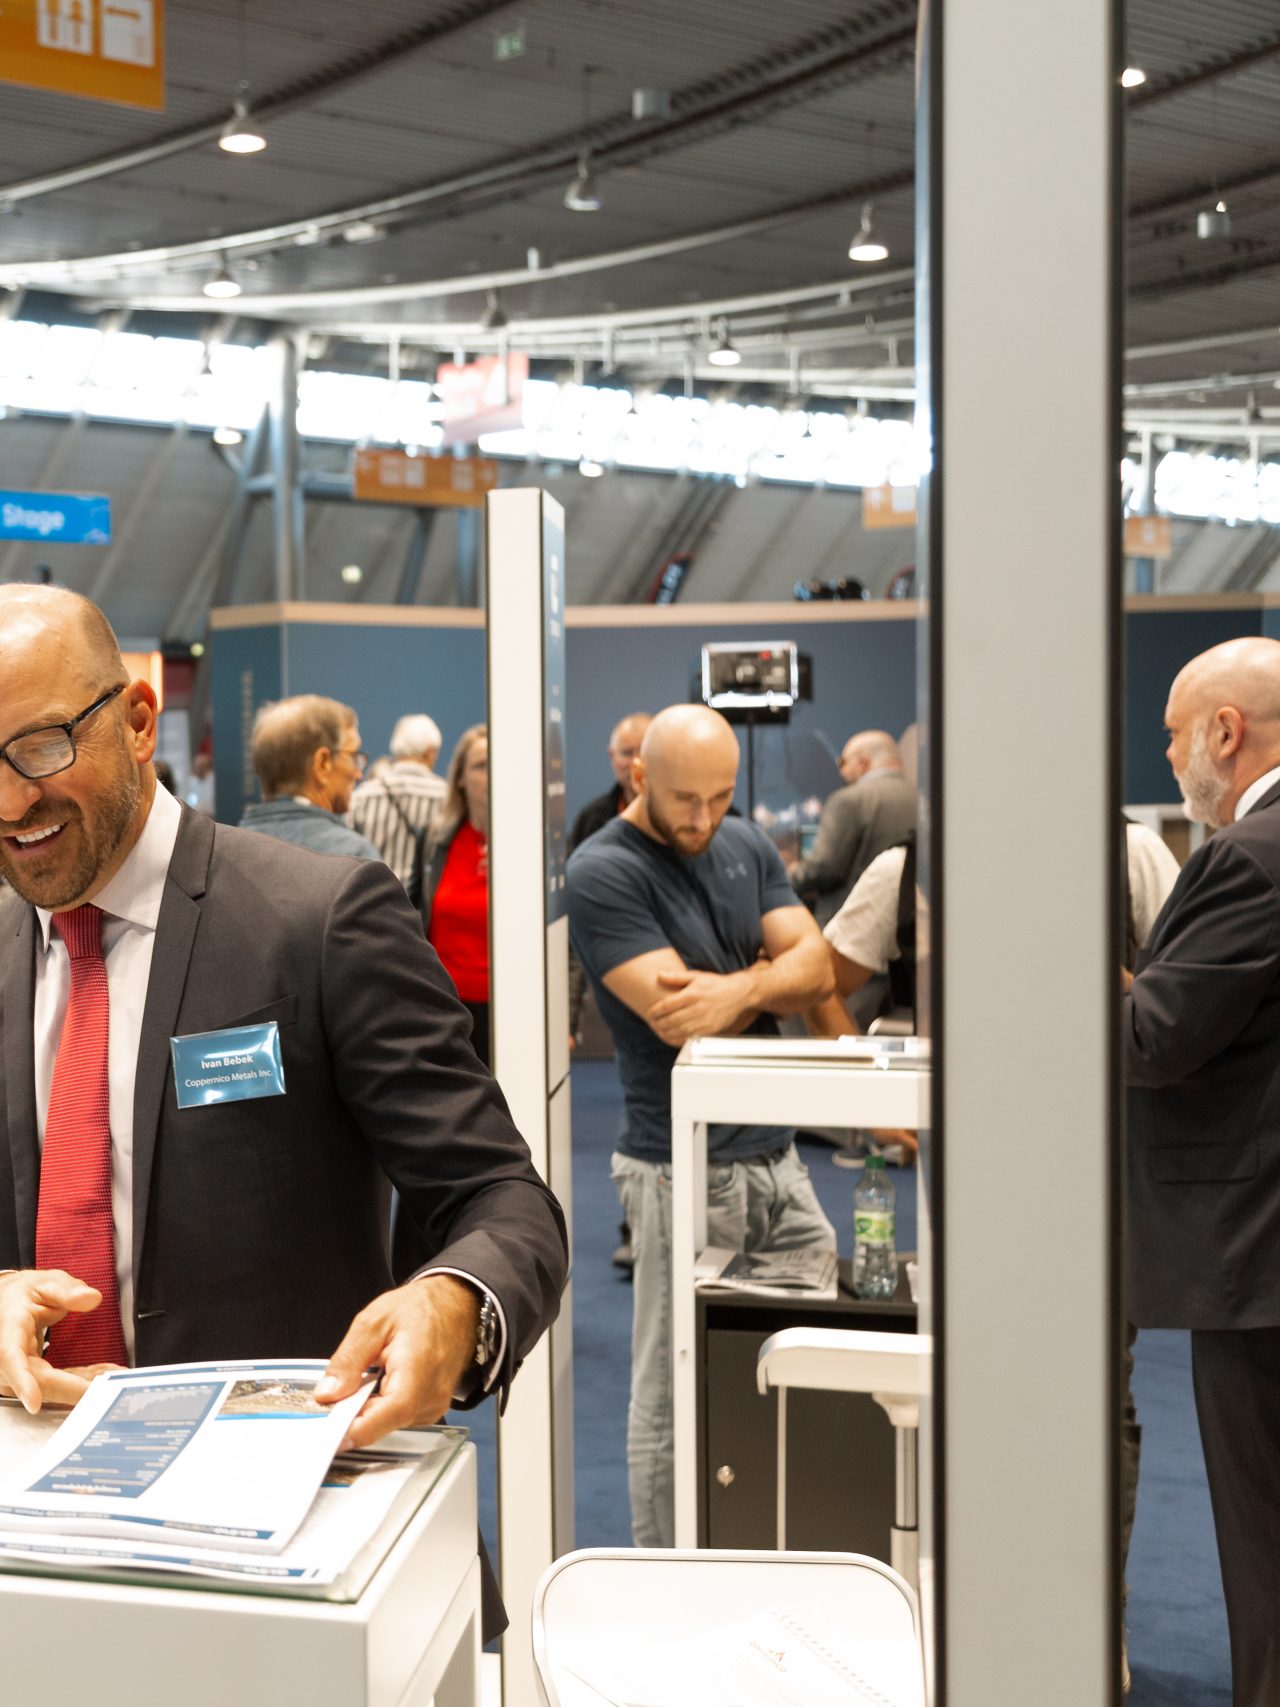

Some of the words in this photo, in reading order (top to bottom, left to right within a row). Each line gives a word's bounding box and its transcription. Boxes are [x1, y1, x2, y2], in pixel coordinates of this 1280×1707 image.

[1, 503, 65, 536] Stage
[201, 1058, 222, 1069] Ivan
[223, 1054, 254, 1067] Bebek
[184, 1075, 231, 1088] Coppernico
[231, 1070, 258, 1082] Metals
[258, 1069, 273, 1078] Inc.
